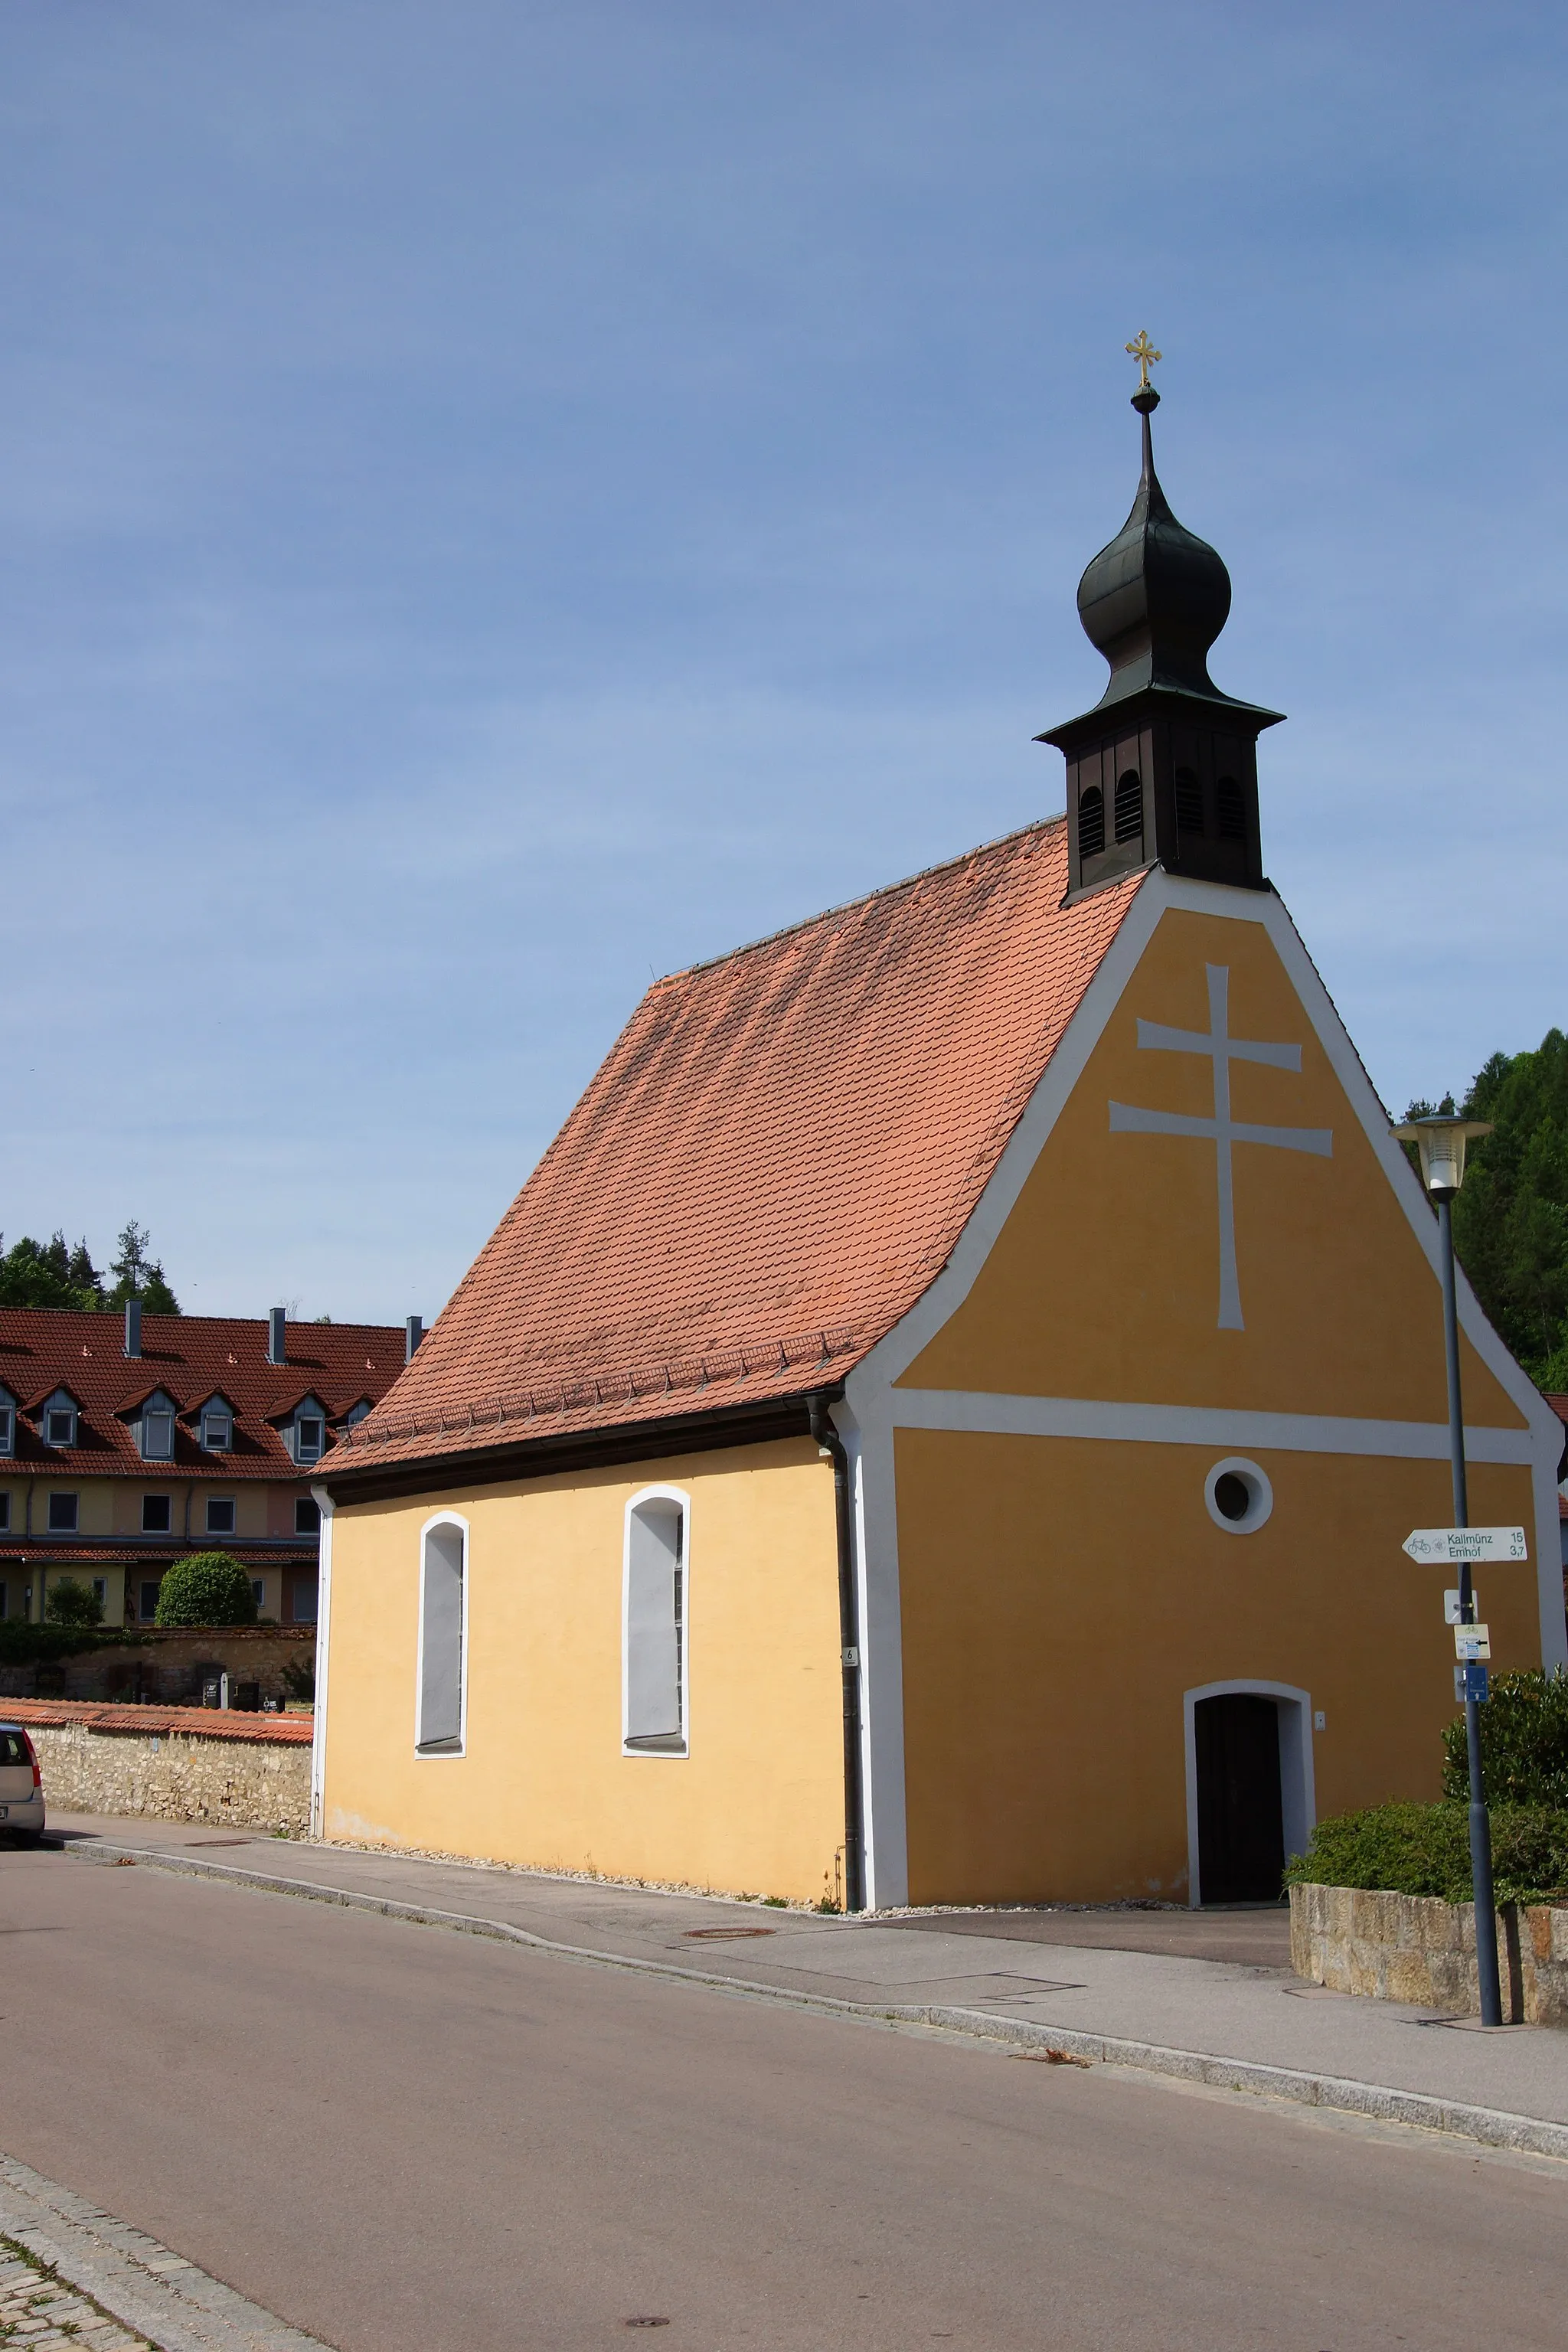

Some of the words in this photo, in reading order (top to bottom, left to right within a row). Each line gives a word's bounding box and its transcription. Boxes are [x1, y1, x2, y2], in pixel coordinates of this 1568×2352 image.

[1447, 1534, 1493, 1544] Kallmünz
[1511, 1532, 1524, 1543] 15
[1449, 1547, 1481, 1557] Emhof
[1510, 1545, 1524, 1557] 3,7
[848, 1650, 853, 1659] 6
